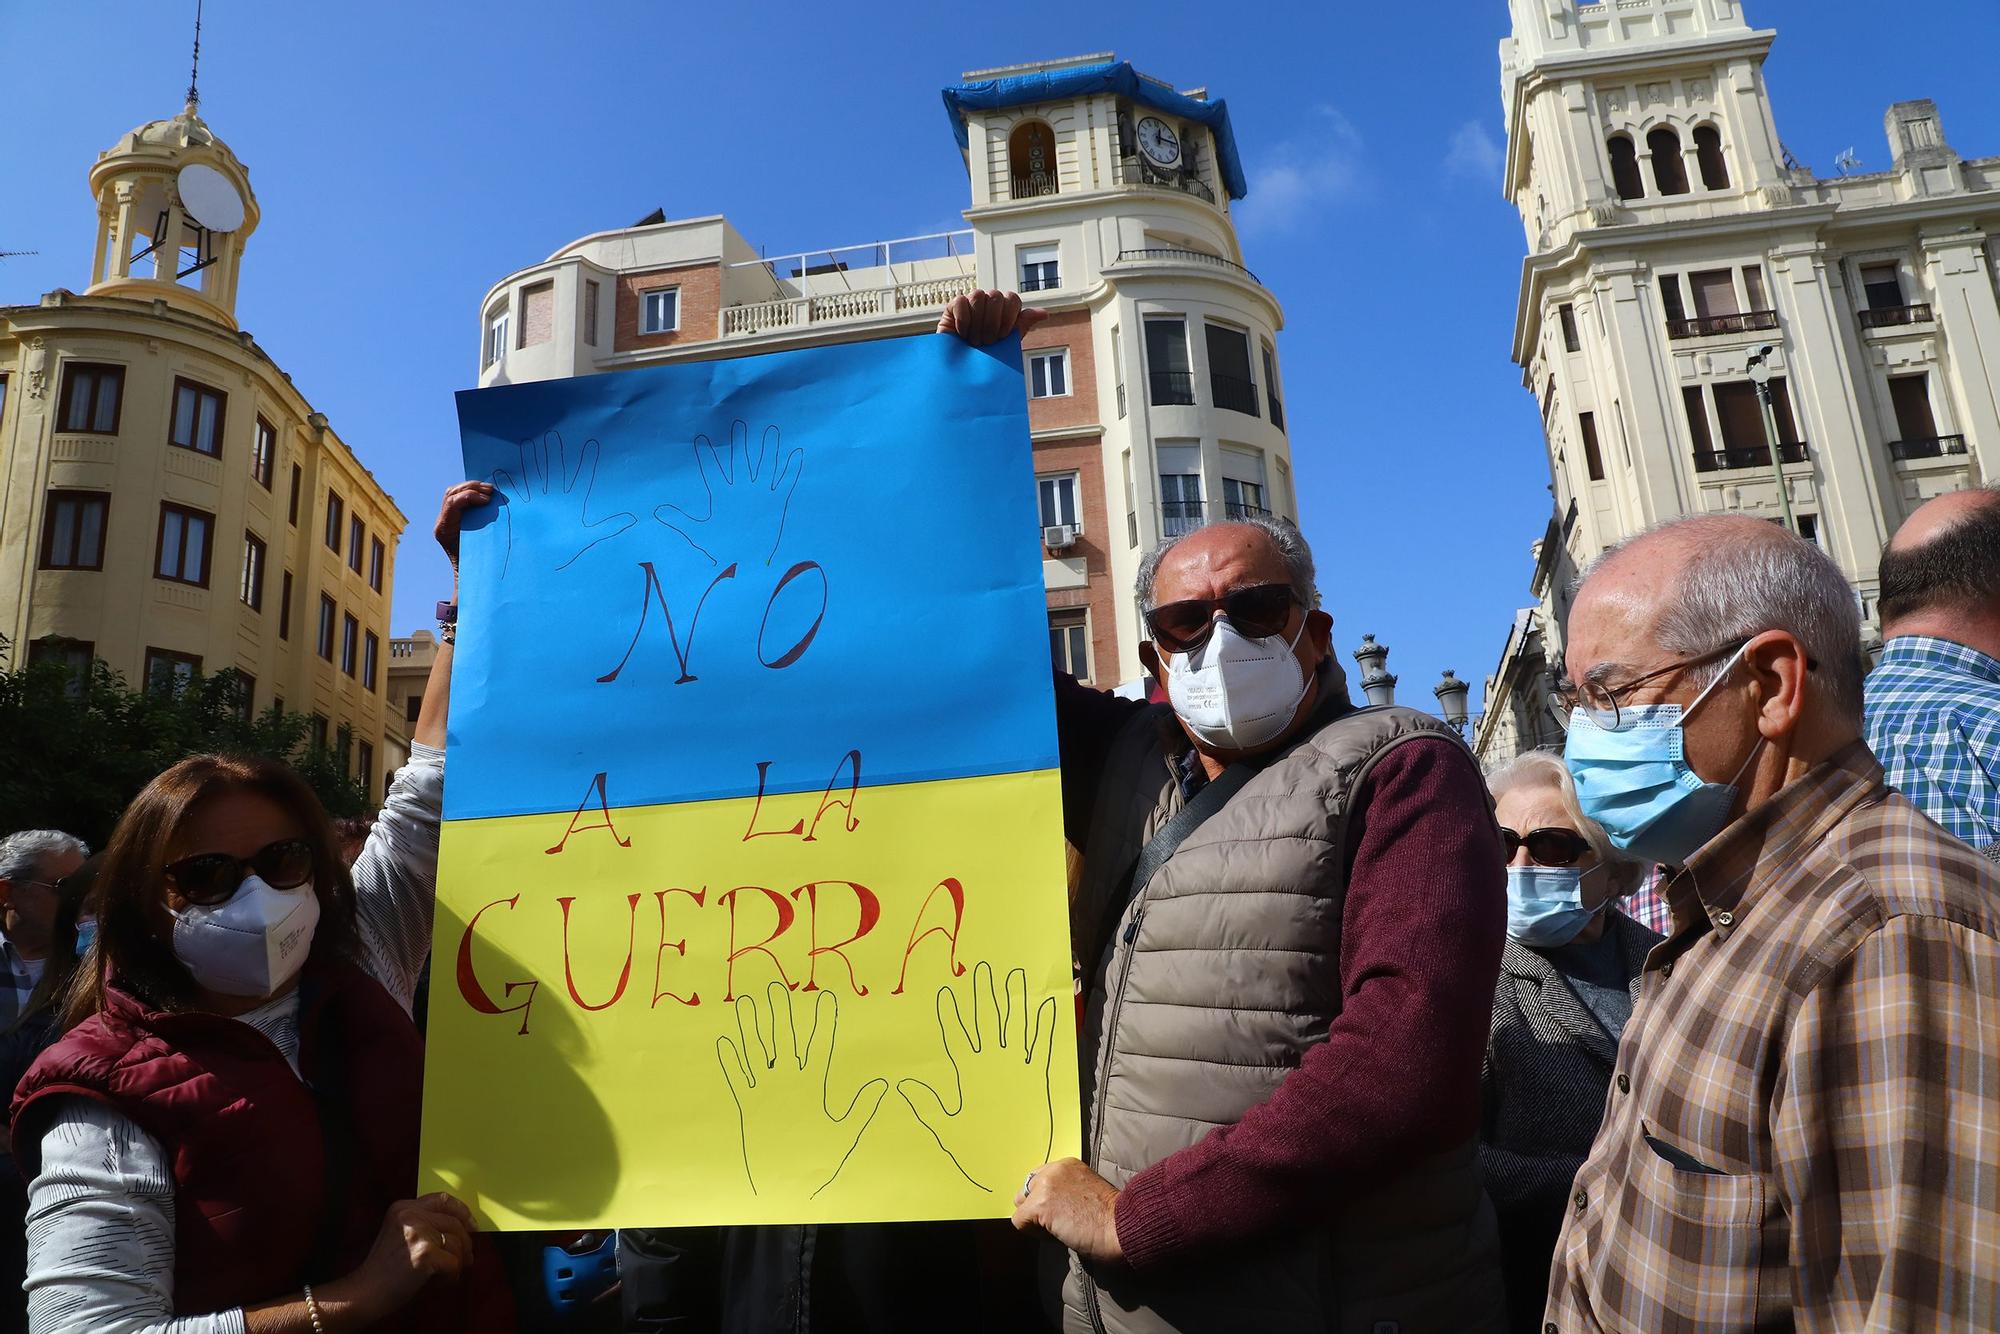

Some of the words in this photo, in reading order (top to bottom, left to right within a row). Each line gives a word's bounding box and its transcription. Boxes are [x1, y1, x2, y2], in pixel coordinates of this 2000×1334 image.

[596, 560, 829, 684] NO
[544, 771, 632, 854] A
[741, 748, 863, 842] LA
[455, 876, 968, 1036] GUERRA
